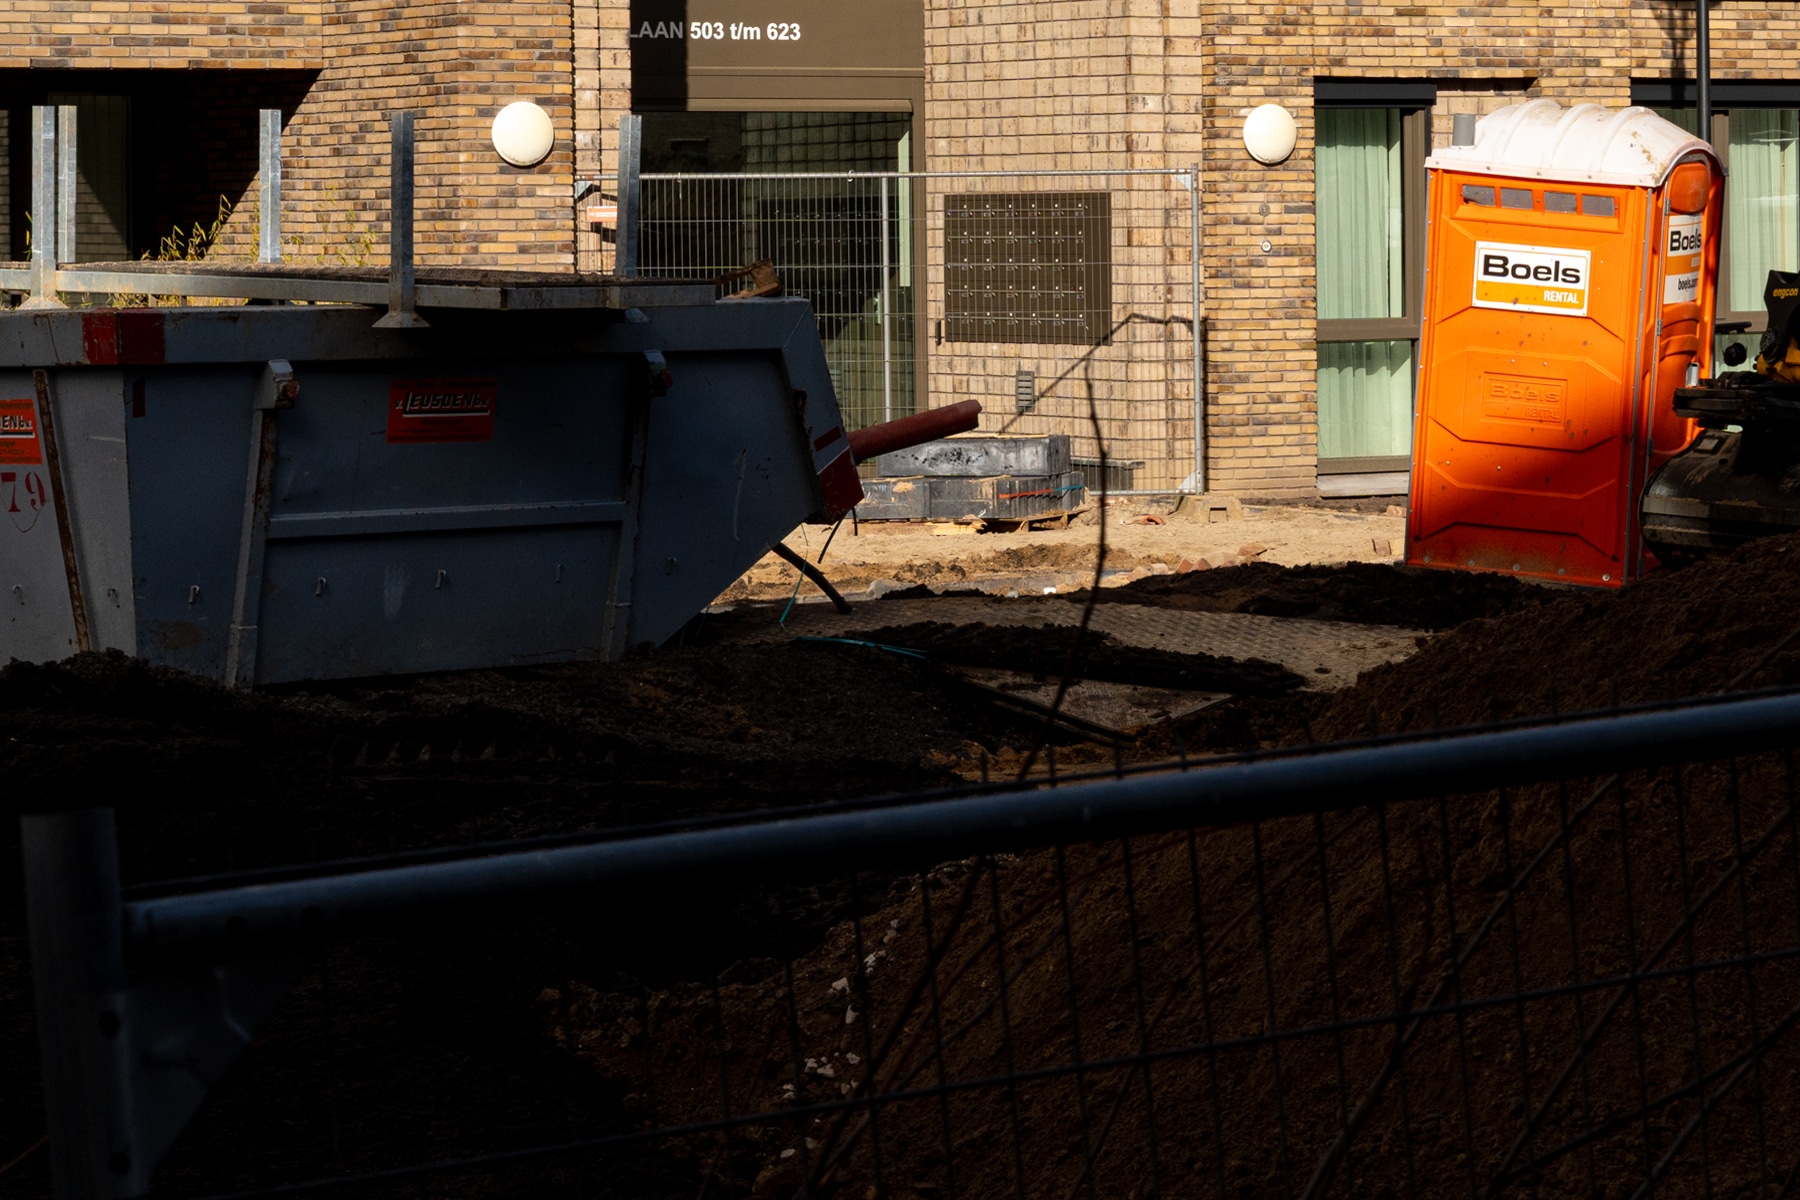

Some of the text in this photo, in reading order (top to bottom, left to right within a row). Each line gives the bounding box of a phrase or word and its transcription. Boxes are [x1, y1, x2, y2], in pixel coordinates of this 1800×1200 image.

[690, 22, 724, 40] 503
[730, 22, 761, 40] t/m
[766, 23, 801, 40] 623
[1669, 228, 1702, 252] Boels
[1483, 254, 1581, 284] Boels
[1543, 290, 1579, 304] RENTAL
[1489, 384, 1560, 403] Boels
